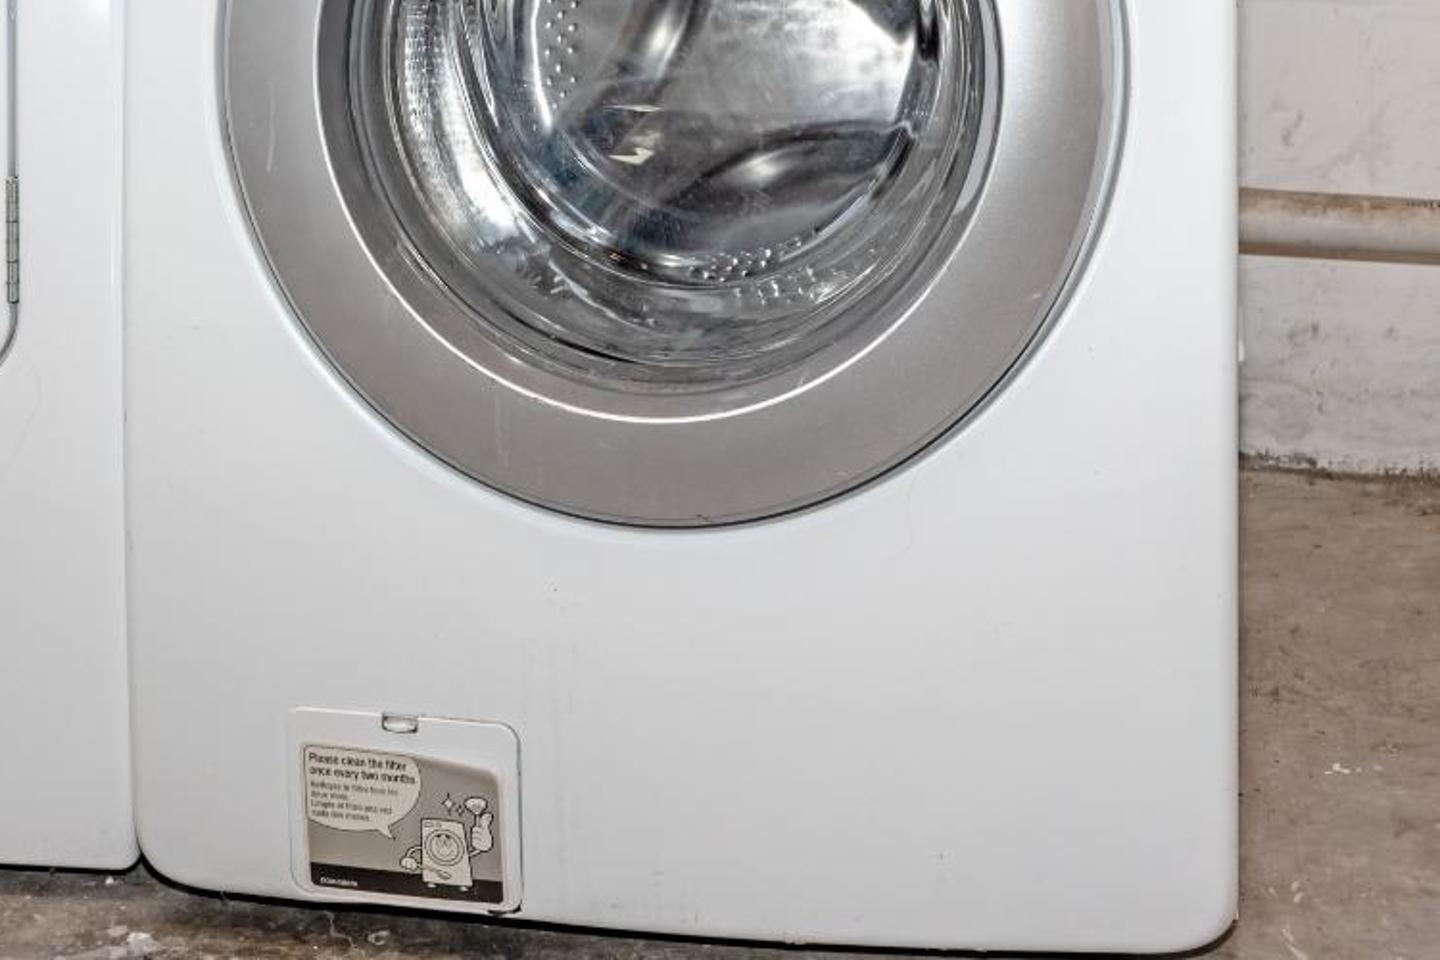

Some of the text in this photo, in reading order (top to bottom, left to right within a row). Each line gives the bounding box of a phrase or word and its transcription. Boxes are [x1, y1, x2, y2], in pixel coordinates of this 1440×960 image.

[309, 752, 339, 764] Please
[341, 756, 365, 766] clean
[368, 758, 383, 768] the
[309, 766, 331, 776] once
